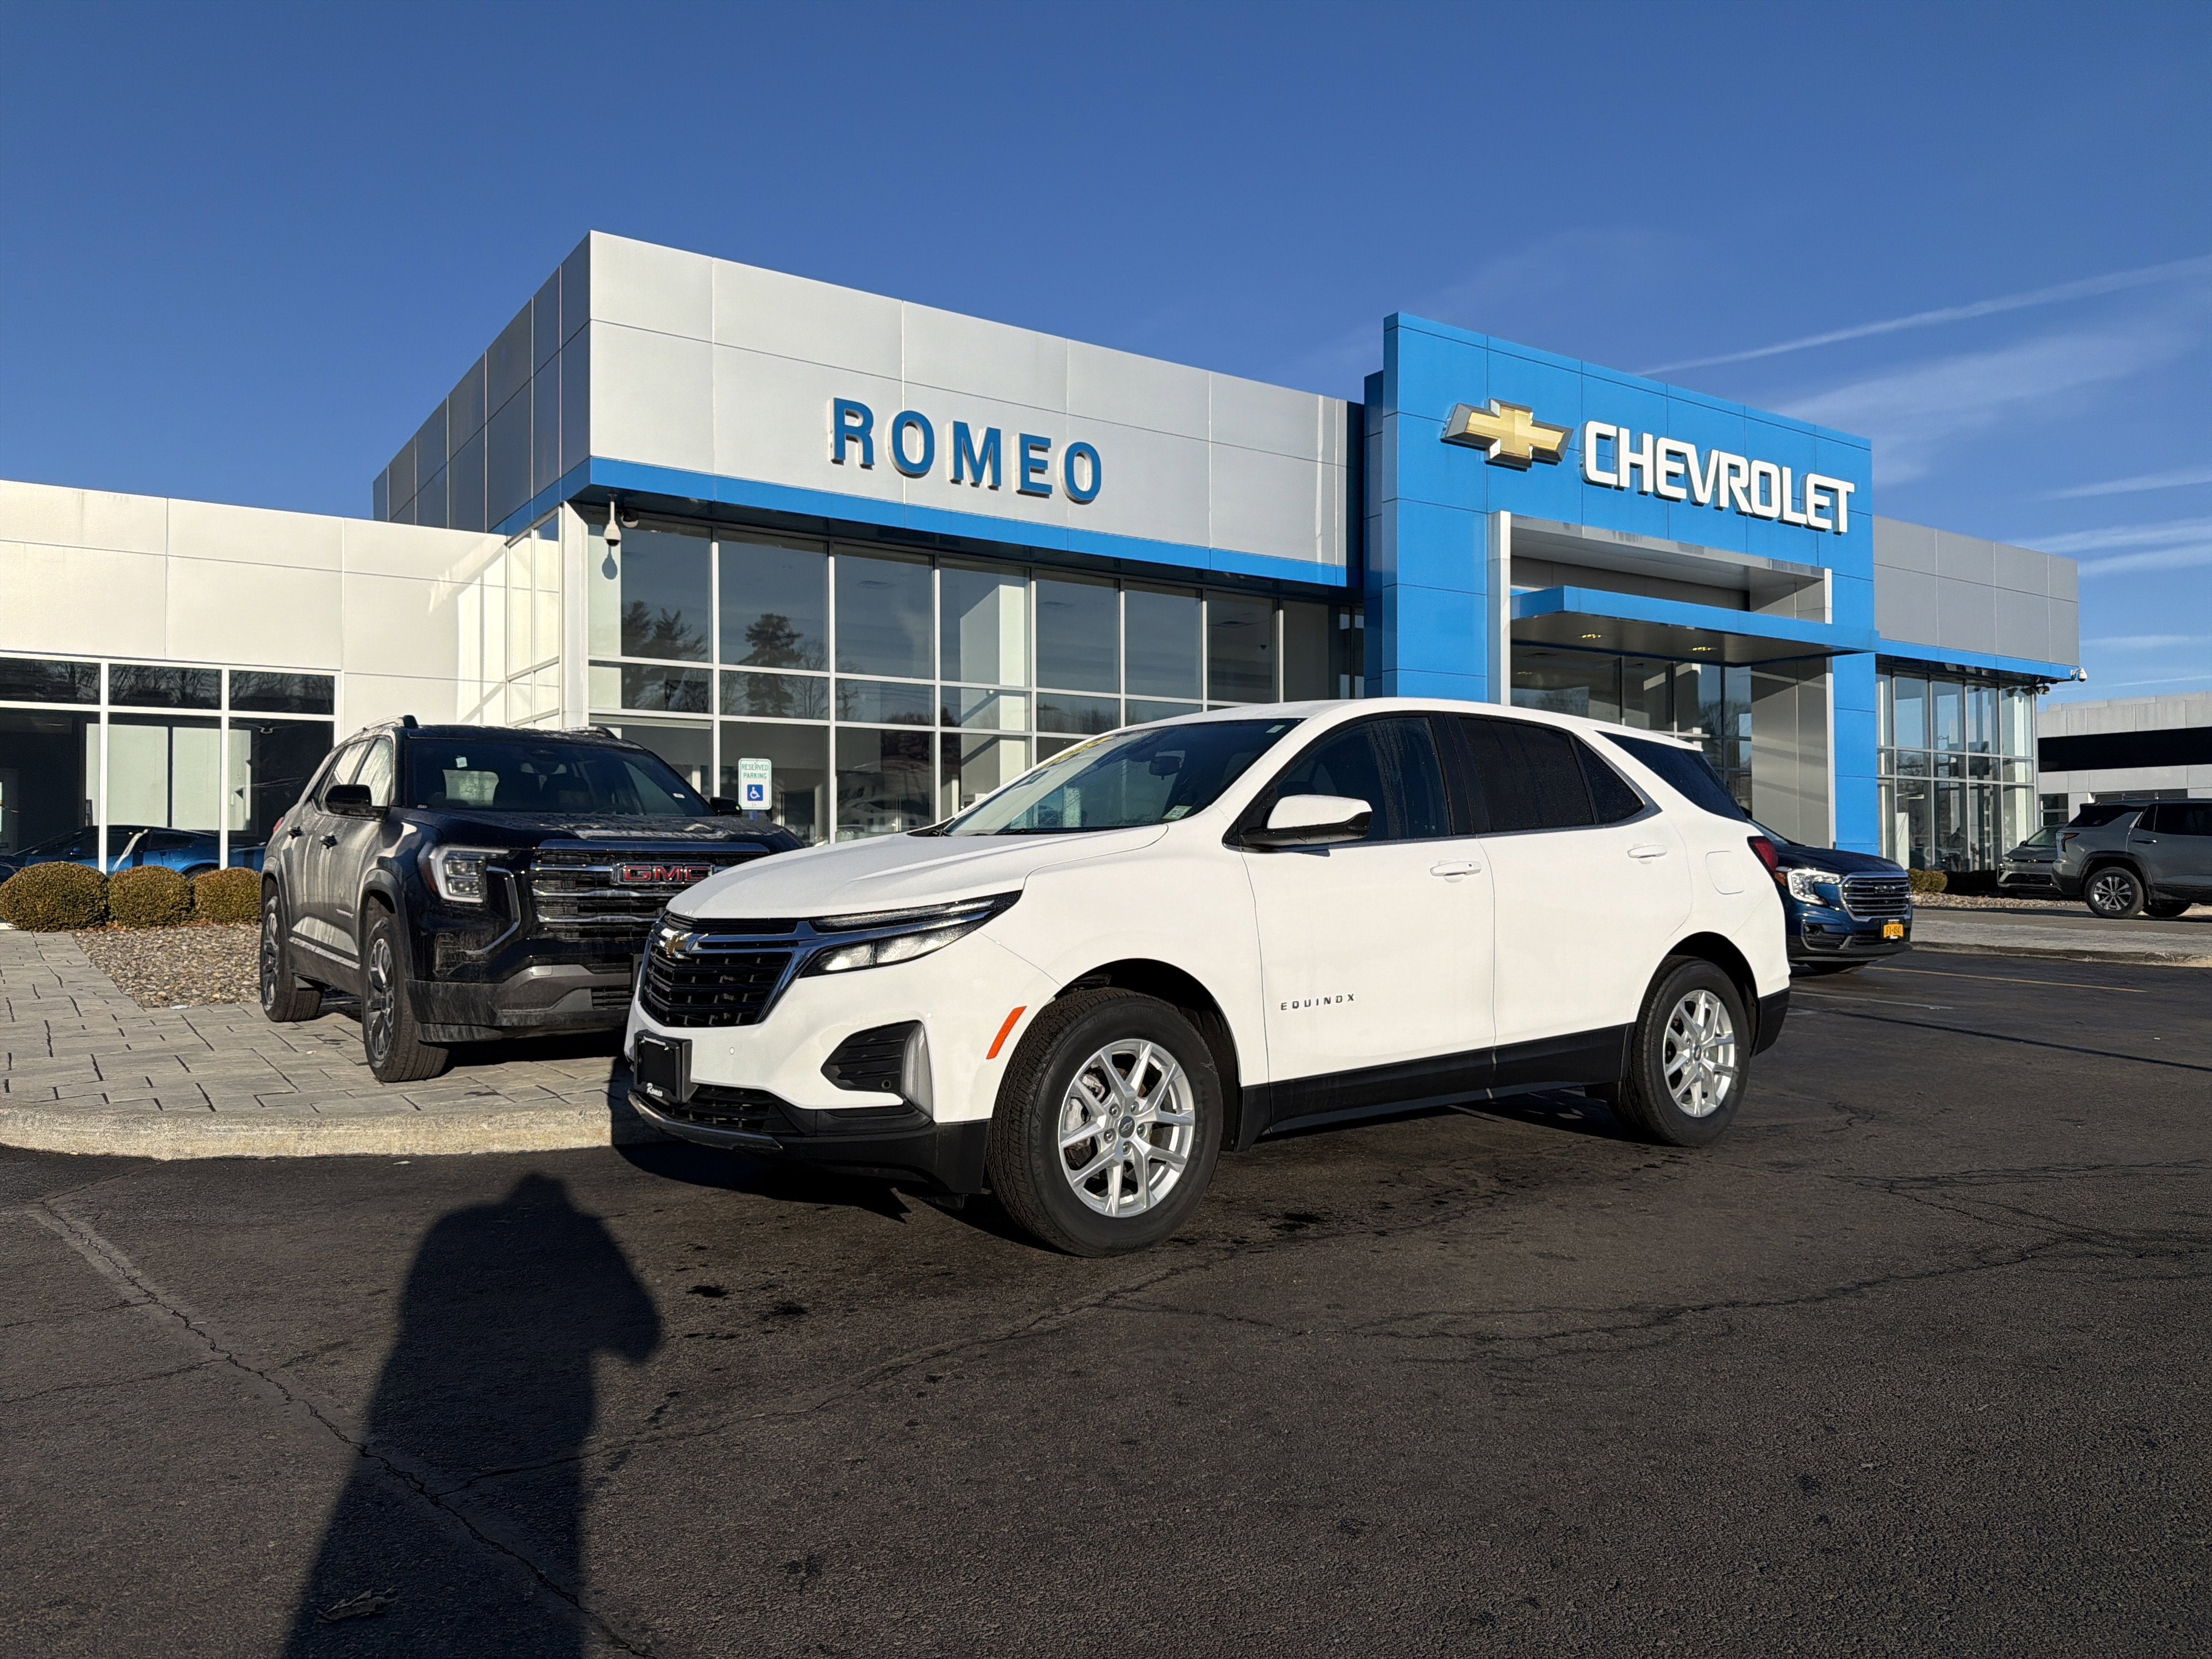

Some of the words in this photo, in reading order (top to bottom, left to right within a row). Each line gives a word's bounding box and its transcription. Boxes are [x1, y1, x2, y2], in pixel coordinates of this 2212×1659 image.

[831, 397, 1102, 504] ROMEO
[1581, 420, 1855, 533] CHEVROLET
[624, 865, 713, 882] GMC
[1280, 994, 1355, 1011] EQUINOX
